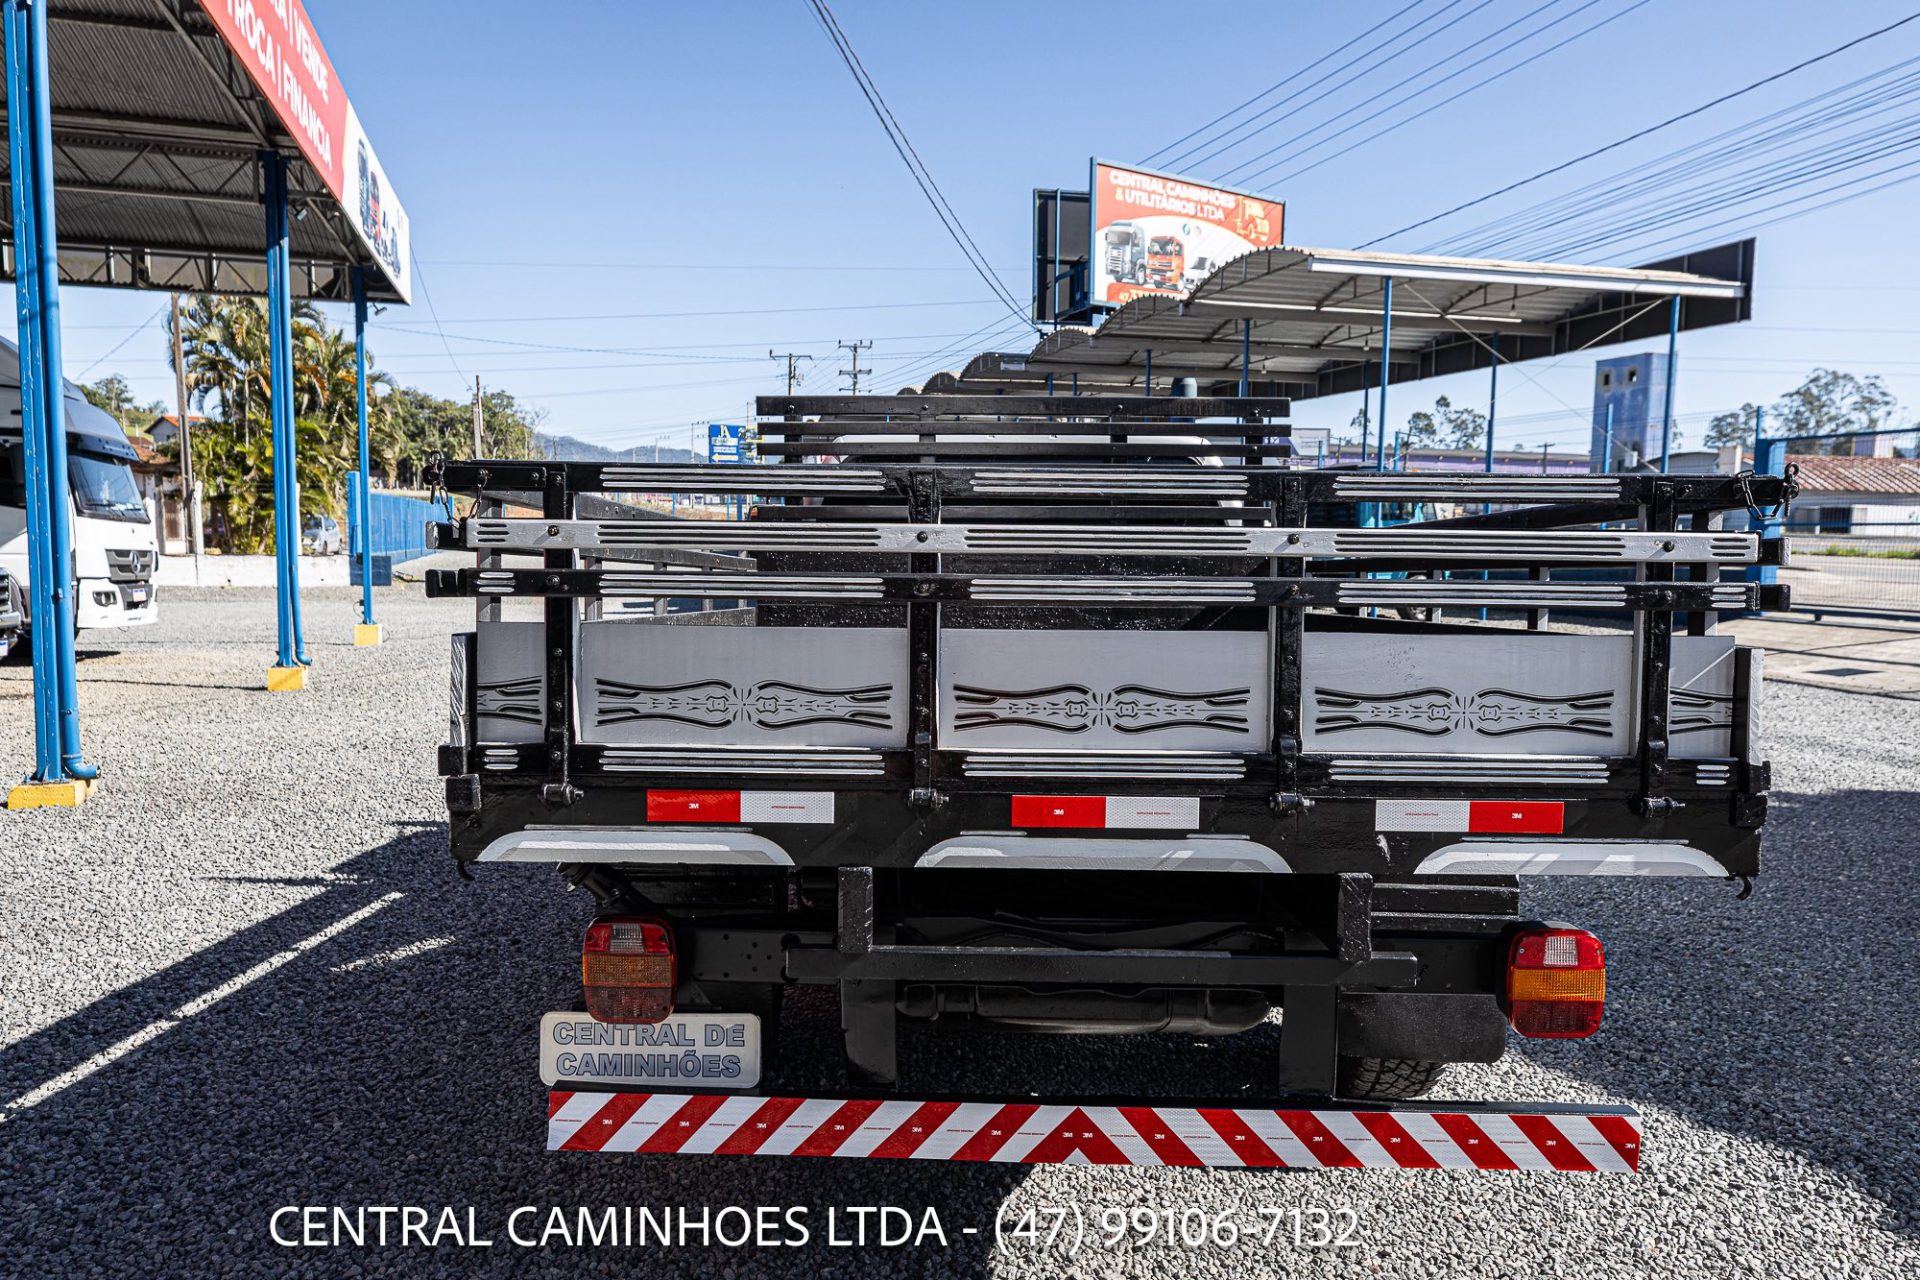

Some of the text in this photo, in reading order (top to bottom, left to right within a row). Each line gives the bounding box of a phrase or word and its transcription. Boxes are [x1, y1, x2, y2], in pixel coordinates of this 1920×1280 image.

[293, 8, 329, 105] VENDE
[283, 60, 333, 171] FINANCIA
[1109, 170, 1236, 208] CENTRAL CAMINHÕES
[1115, 187, 1225, 221] & UTILITÁRIOS LTDA
[553, 1021, 745, 1047] CENTRAL DE
[556, 1050, 741, 1078] CAMINHÕES
